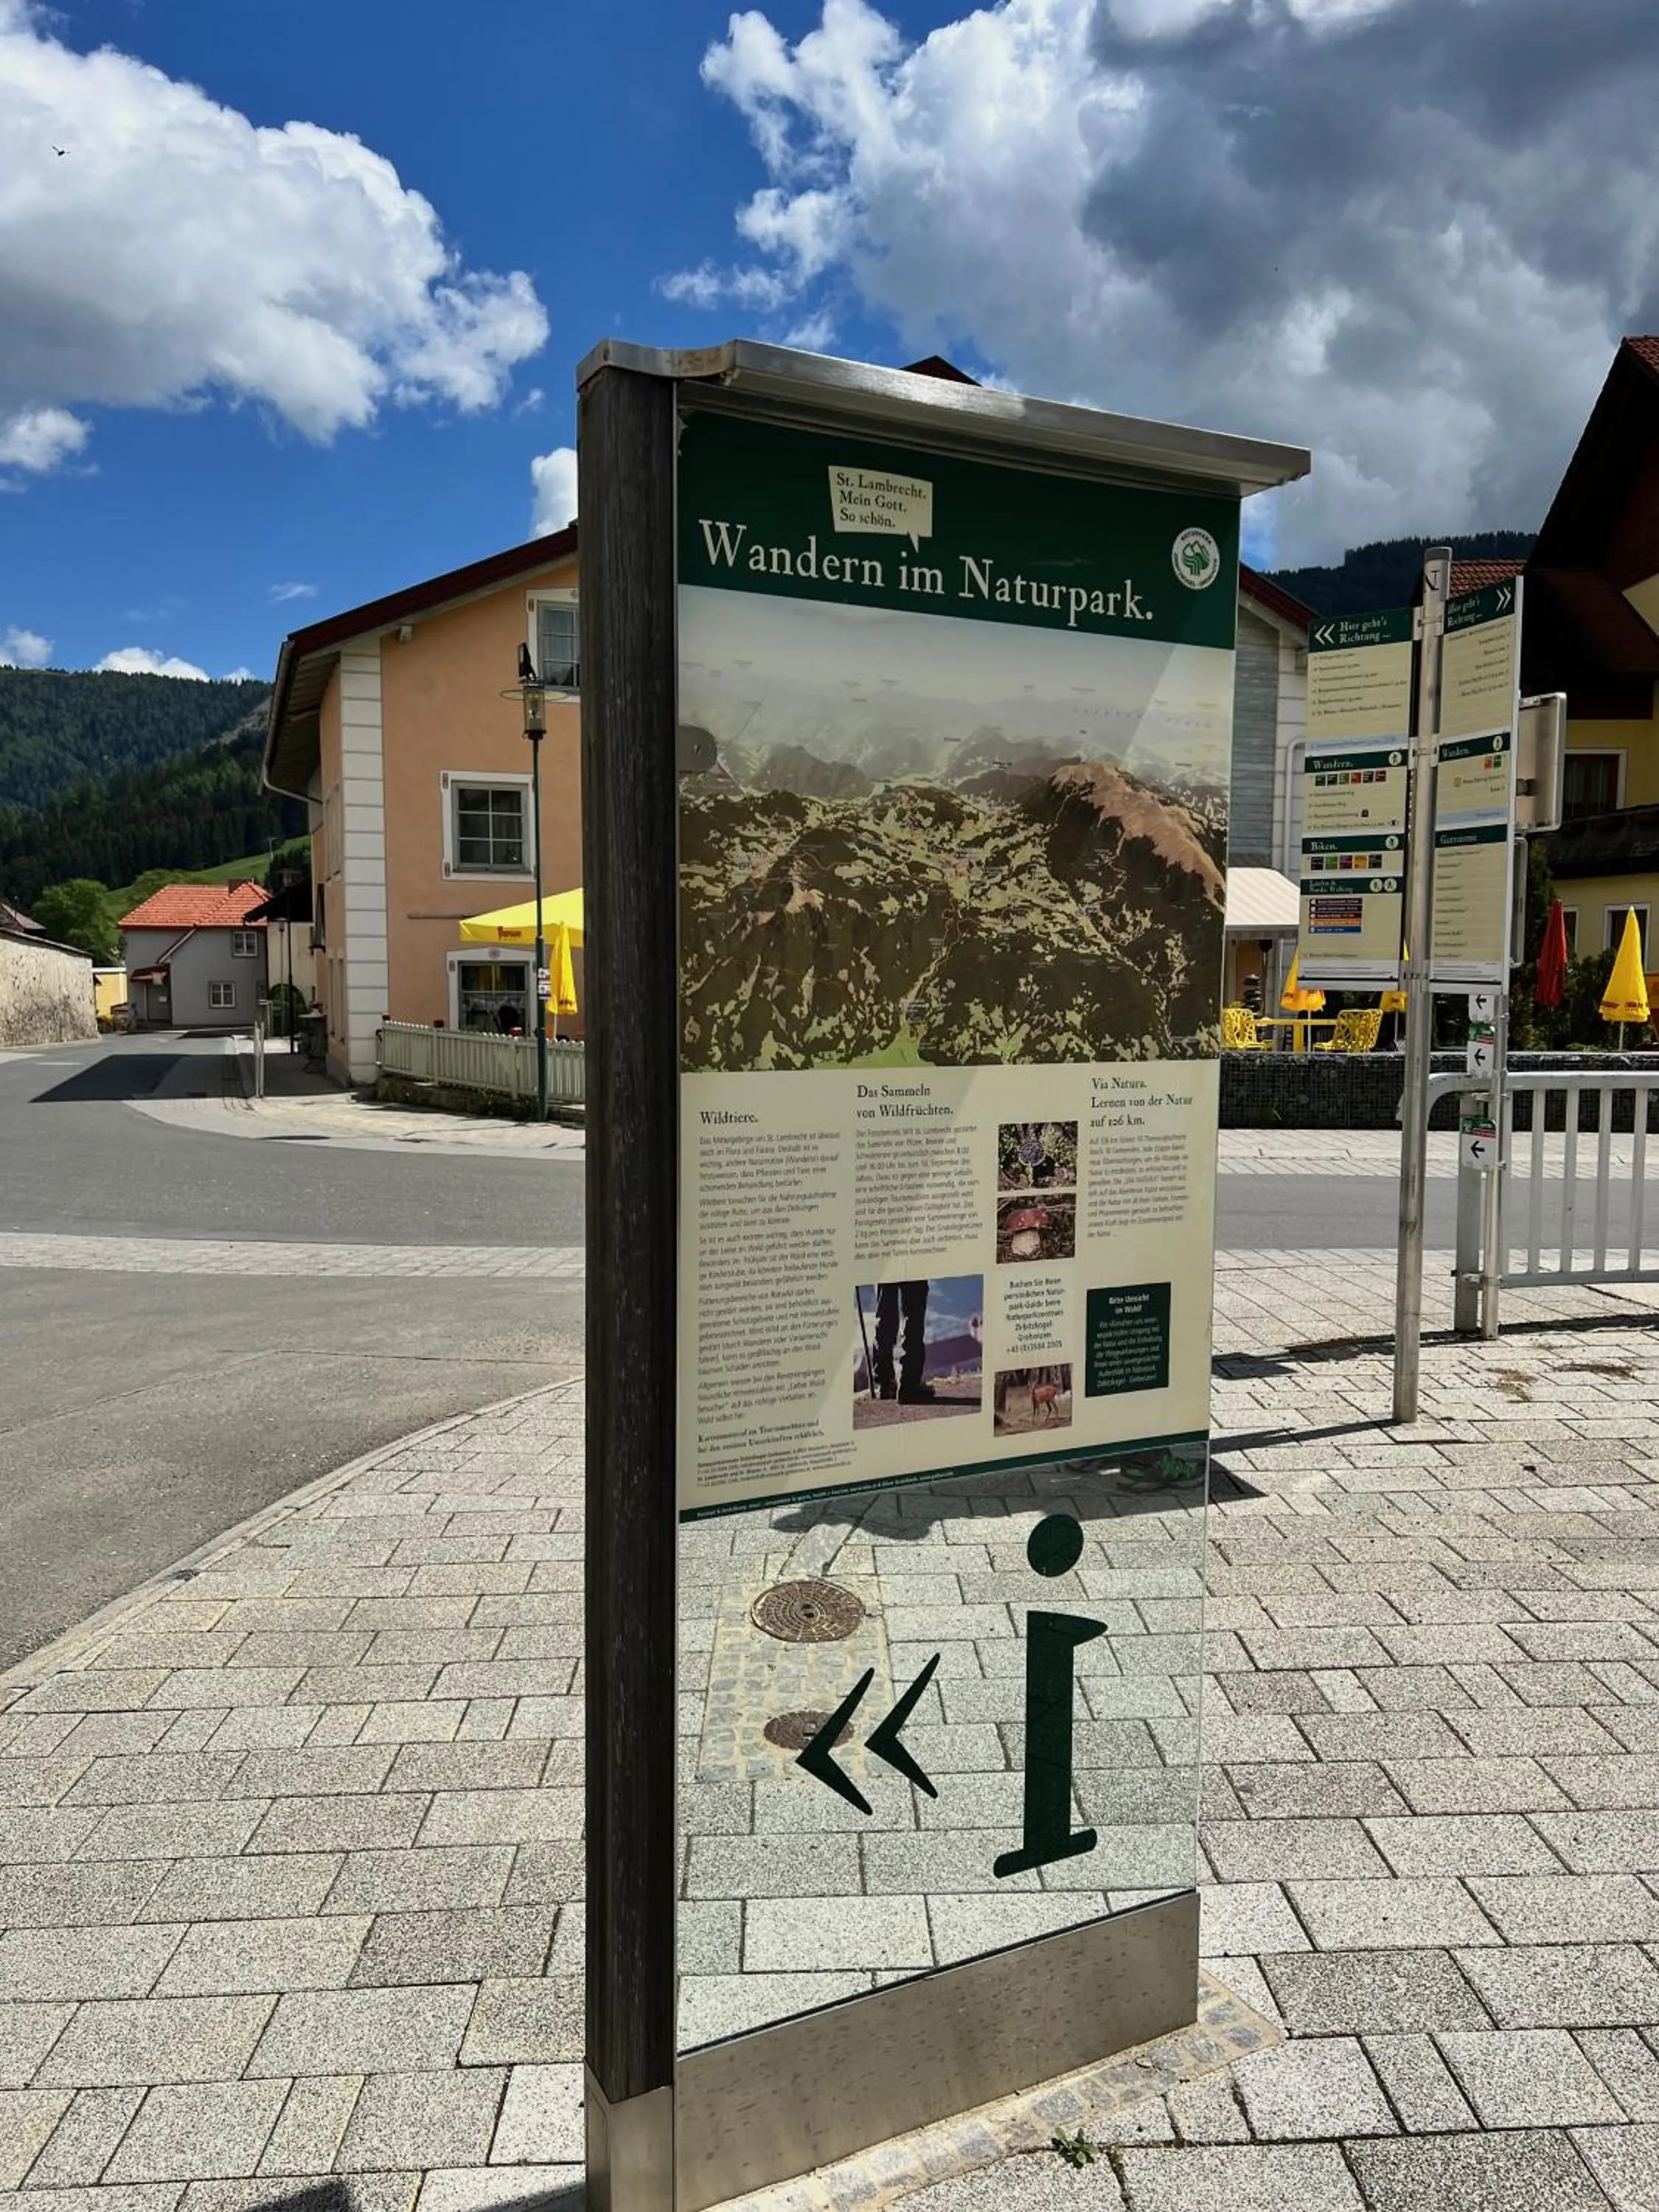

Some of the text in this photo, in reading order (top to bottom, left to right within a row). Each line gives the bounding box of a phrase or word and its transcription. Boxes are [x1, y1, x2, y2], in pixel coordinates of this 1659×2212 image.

[837, 472, 926, 499] St. Lambrecht.
[840, 490, 871, 507] Mein
[841, 507, 895, 528] So schön.
[698, 518, 885, 587] Wandern
[899, 551, 945, 594] im
[959, 555, 1153, 627] Naturpark.
[1339, 622, 1360, 632] Hier
[1339, 632, 1380, 643] Richtung
[857, 1082, 931, 1098] Das Sammeln
[1091, 1077, 1147, 1090] Via Natura.
[1091, 1093, 1193, 1108] Lernen von der Natur
[700, 1110, 759, 1125] Wildtiere.
[856, 1103, 953, 1119] von Wildfrüchten.
[1090, 1116, 1106, 1127] auf
[1127, 1115, 1145, 1127] km.
